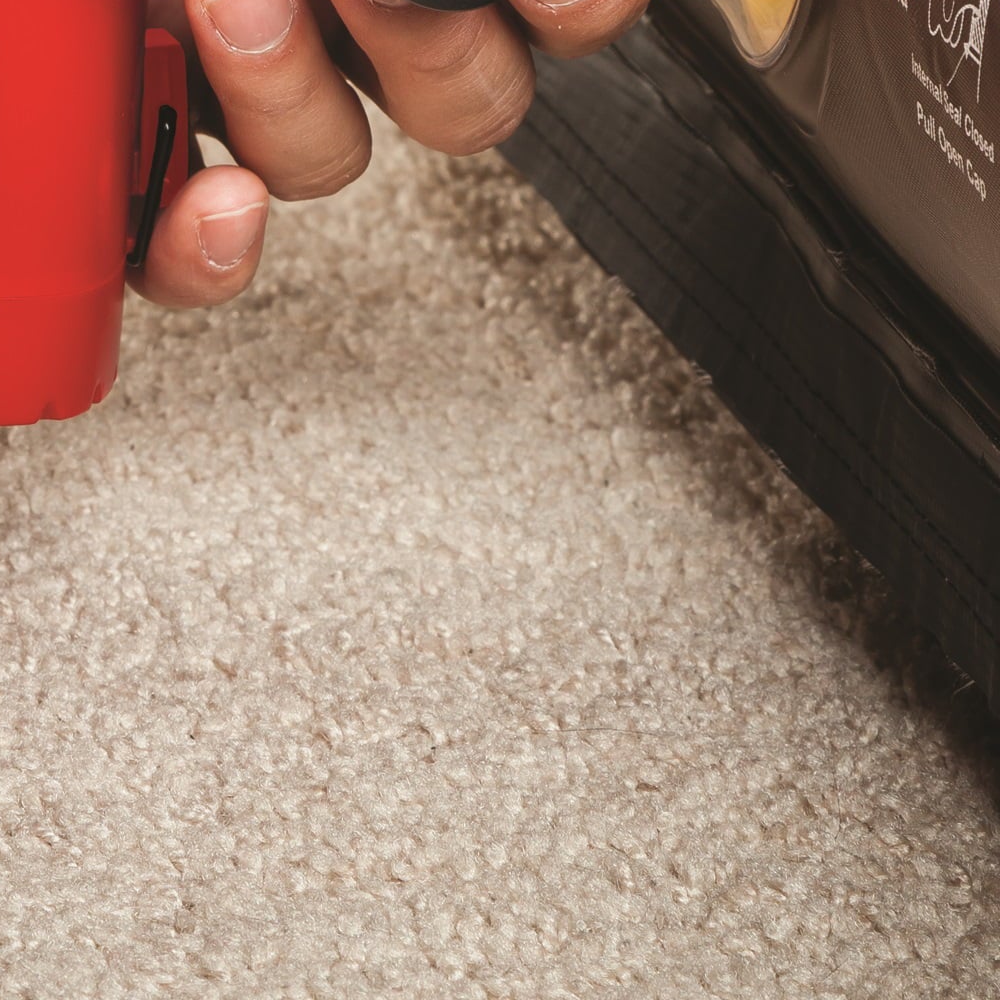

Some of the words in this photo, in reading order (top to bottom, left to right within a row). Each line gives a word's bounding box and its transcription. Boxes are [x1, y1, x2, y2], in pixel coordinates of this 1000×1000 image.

[911, 52, 943, 105] Internal
[943, 90, 962, 128] Seal
[964, 114, 995, 164] Closed
[916, 101, 936, 142] Pull
[938, 126, 965, 173] Open
[966, 158, 987, 202] Cap
